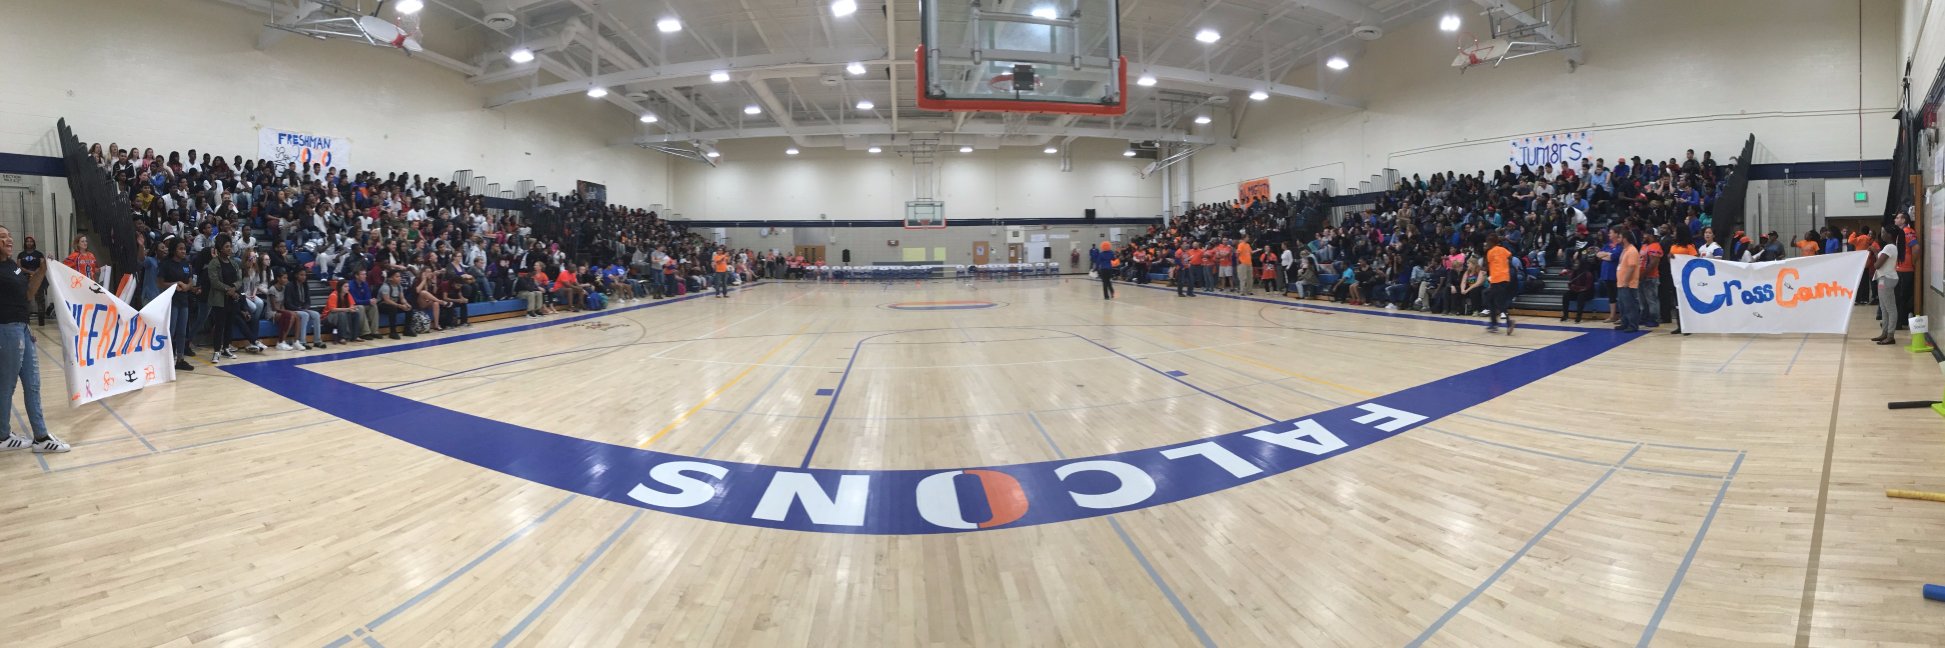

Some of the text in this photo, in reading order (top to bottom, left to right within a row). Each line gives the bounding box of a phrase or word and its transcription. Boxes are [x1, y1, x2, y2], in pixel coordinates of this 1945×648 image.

[278, 133, 332, 149] FRESHMAN
[1681, 258, 1775, 314] Cross
[626, 402, 1429, 530] FALCONS
